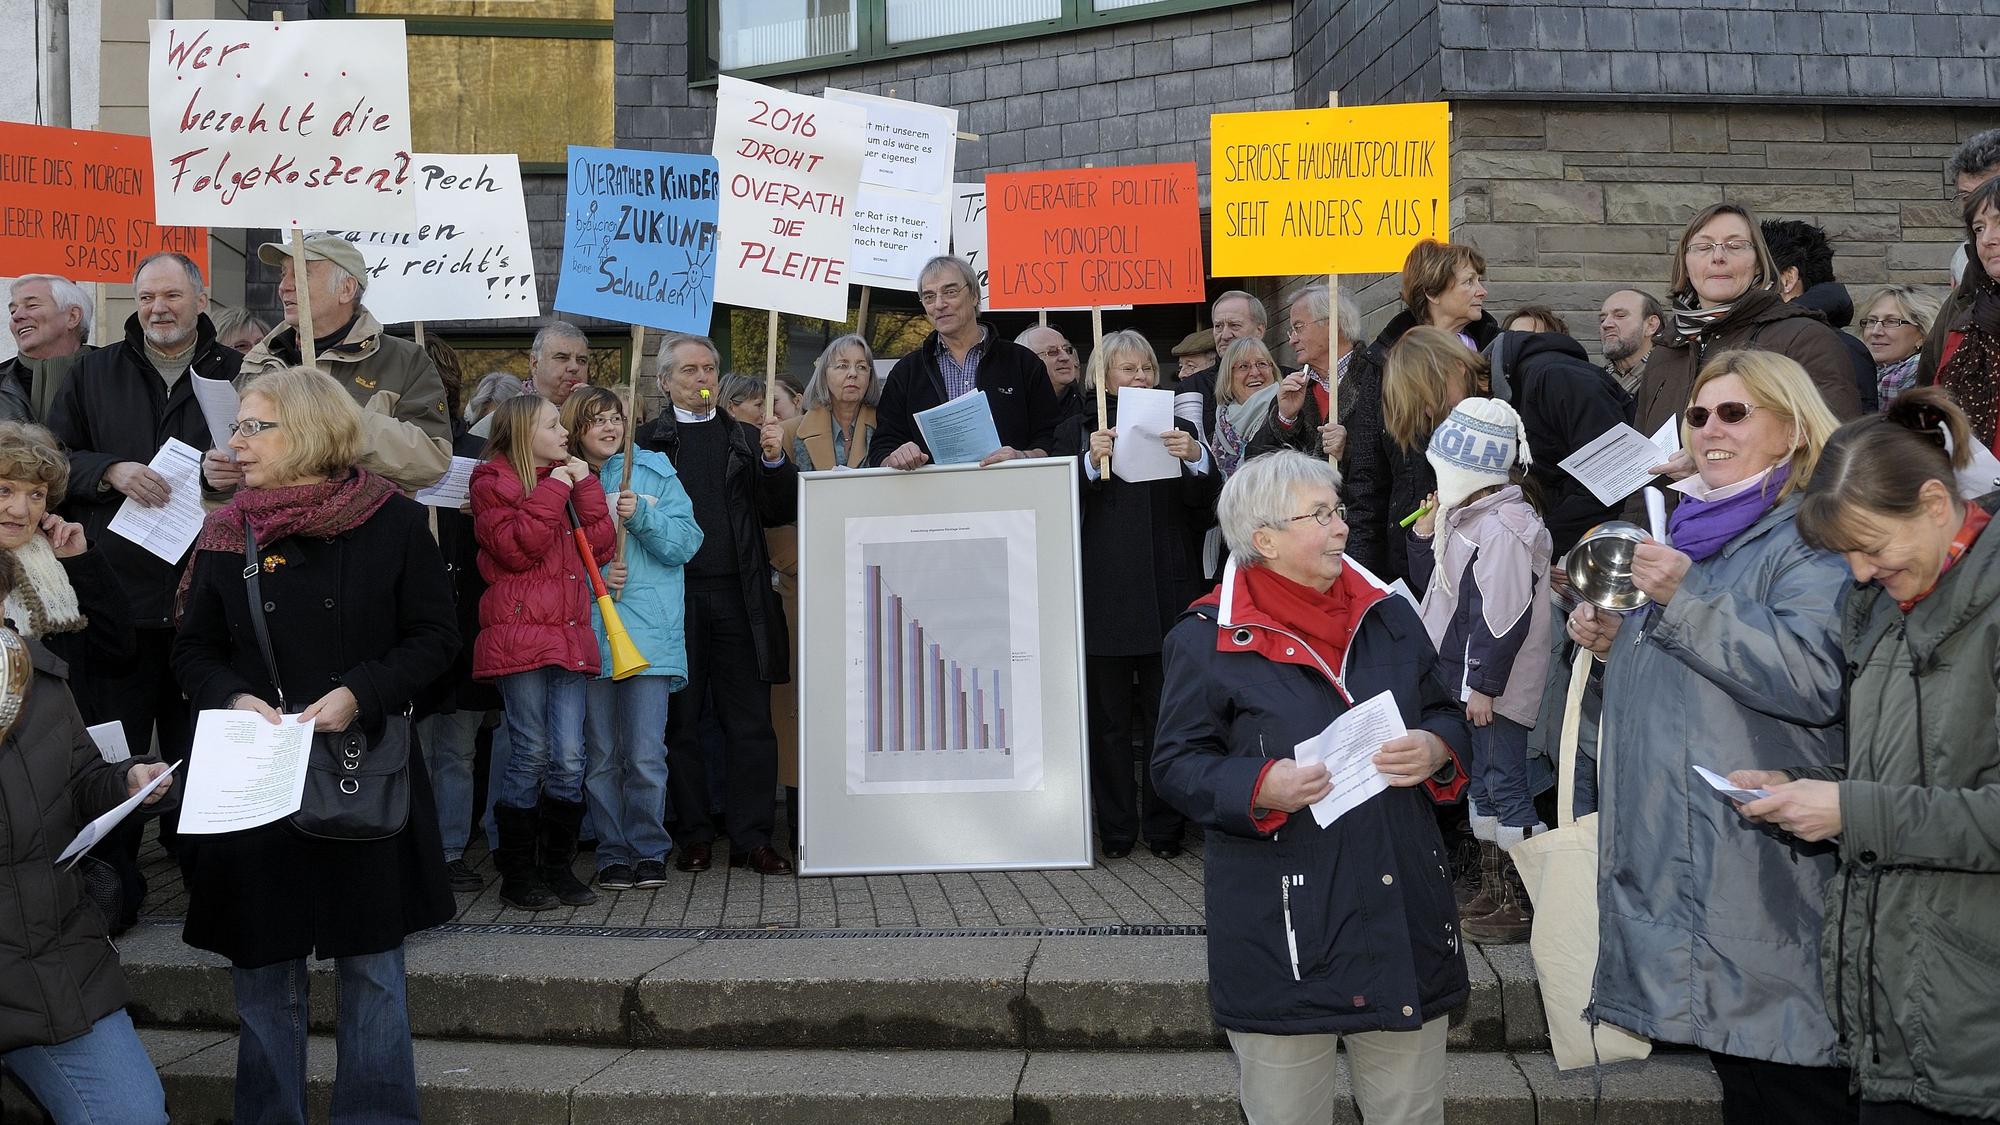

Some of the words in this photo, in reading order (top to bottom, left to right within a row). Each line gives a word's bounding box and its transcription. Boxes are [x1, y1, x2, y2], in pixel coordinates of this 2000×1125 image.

[169, 29, 249, 70] Wer
[180, 87, 315, 137] bezahlt
[332, 96, 390, 137] die
[748, 101, 816, 137] 2016
[867, 137, 880, 145] um
[883, 138, 896, 148] als
[875, 123, 890, 133] mit
[893, 127, 930, 139] unserem
[736, 138, 823, 172] DROHT
[881, 152, 917, 164] eigenes!
[1225, 143, 1291, 182] SERIÖSE
[1297, 140, 1435, 180] HAUSHALTSPOLITIK
[84, 163, 143, 196] MORGEN
[421, 164, 503, 192] Pech
[575, 157, 655, 197] OVERATHER
[732, 174, 844, 217] OVERATH
[53, 210, 80, 241] RAT
[86, 215, 116, 245] DAS
[127, 218, 154, 249] IST
[161, 226, 197, 253] KEIN
[769, 217, 805, 237] DIE
[867, 210, 883, 220] Rat
[886, 213, 898, 222] ist
[1226, 201, 1269, 237] SIEHT
[1281, 199, 1363, 237] ANDERS
[855, 238, 876, 246] noch
[879, 239, 908, 251] teurer
[893, 227, 908, 238] Rat
[911, 231, 923, 240] ist
[1044, 225, 1138, 255] MONOPOLI
[402, 245, 509, 276] reicht's
[739, 241, 844, 284] PLEITE
[1003, 261, 1069, 295] LÄSST
[1081, 259, 1172, 293] GRÜSSEN
[487, 274, 531, 300] !!!
[596, 256, 684, 306] Schulden
[1432, 423, 1509, 467] KÖLN
